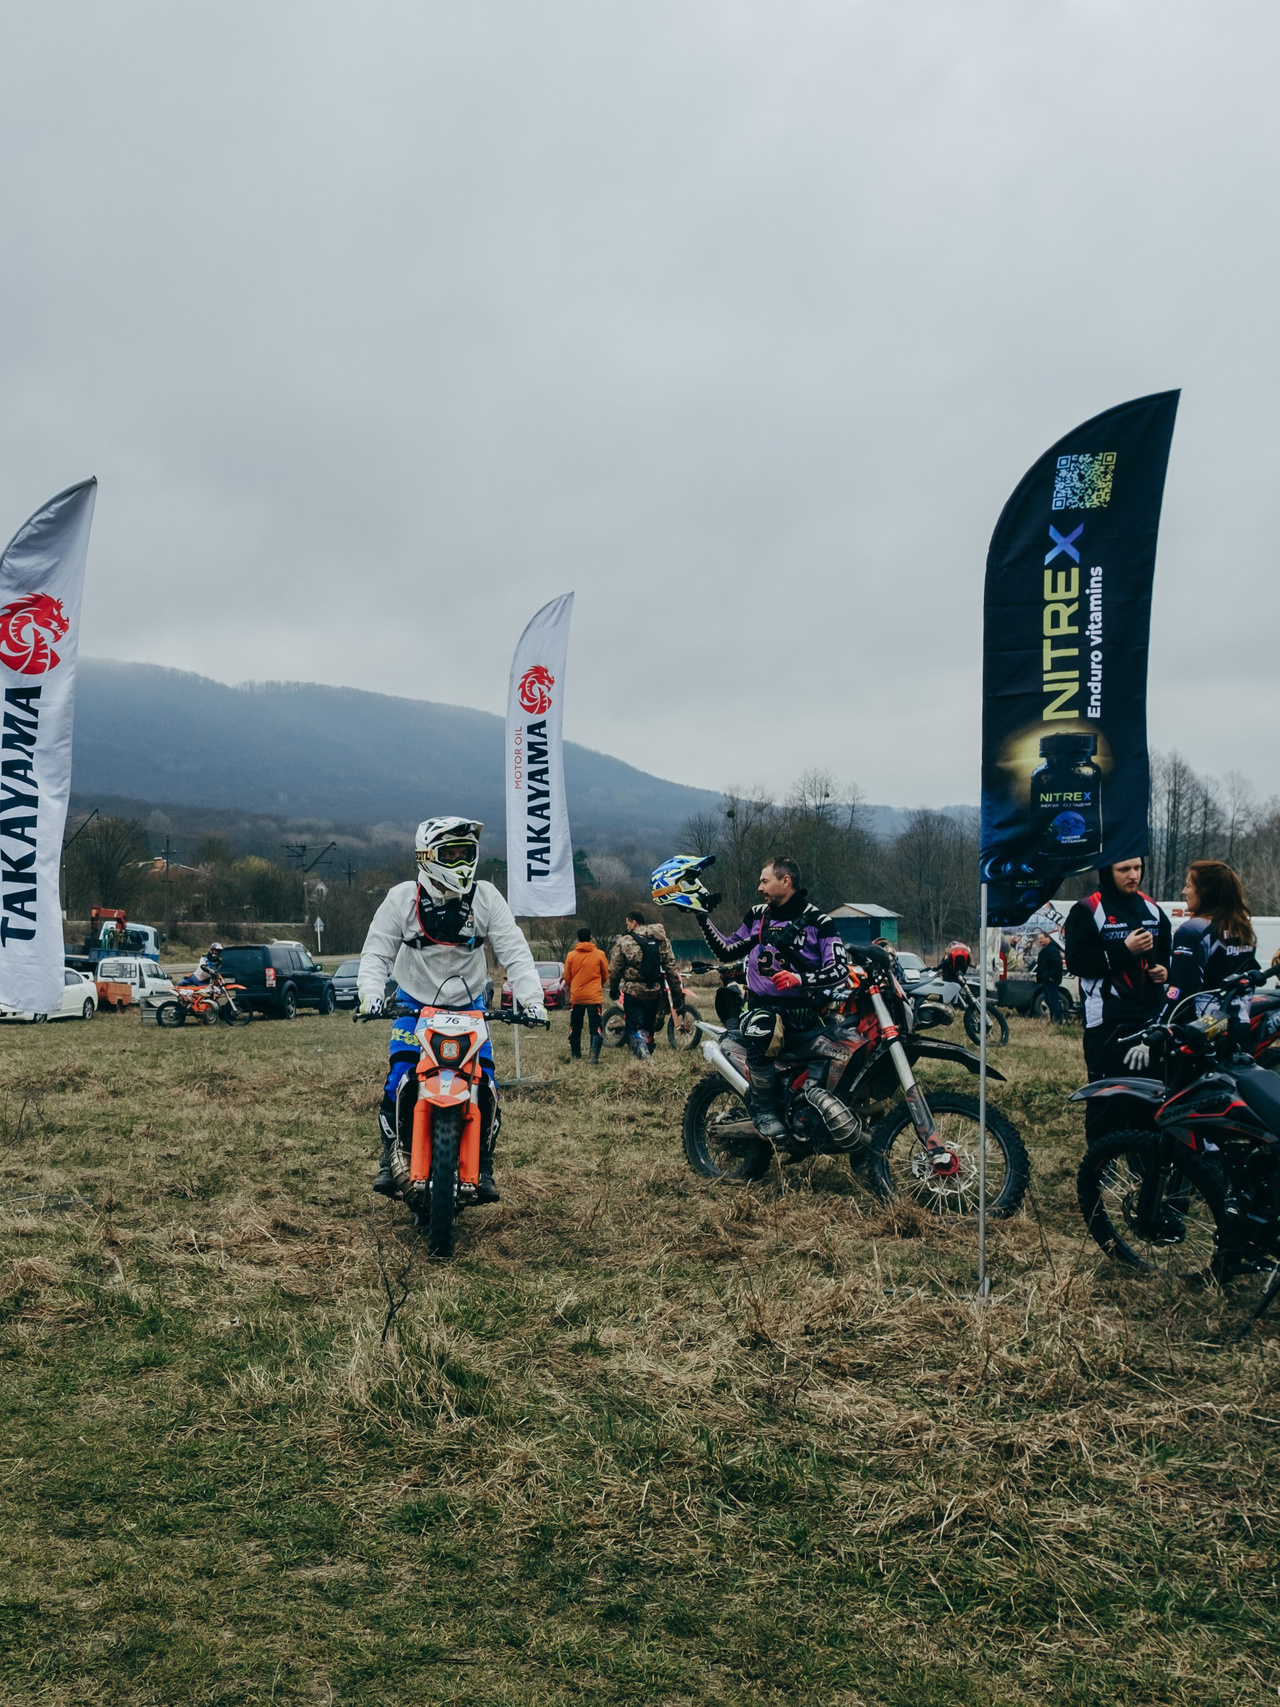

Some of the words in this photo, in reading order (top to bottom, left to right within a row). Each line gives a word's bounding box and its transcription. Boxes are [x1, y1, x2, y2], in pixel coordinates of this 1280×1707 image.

[1042, 523, 1084, 721] NITREX
[1085, 565, 1103, 647] vitamins
[1087, 650, 1102, 719] Enduro
[514, 725, 523, 745] OIL
[514, 746, 523, 790] MOTOR
[0, 684, 42, 948] TAKAYAMA
[526, 719, 551, 883] TAKAYAMA
[1039, 791, 1092, 802] NITREX
[444, 1016, 460, 1025] 76
